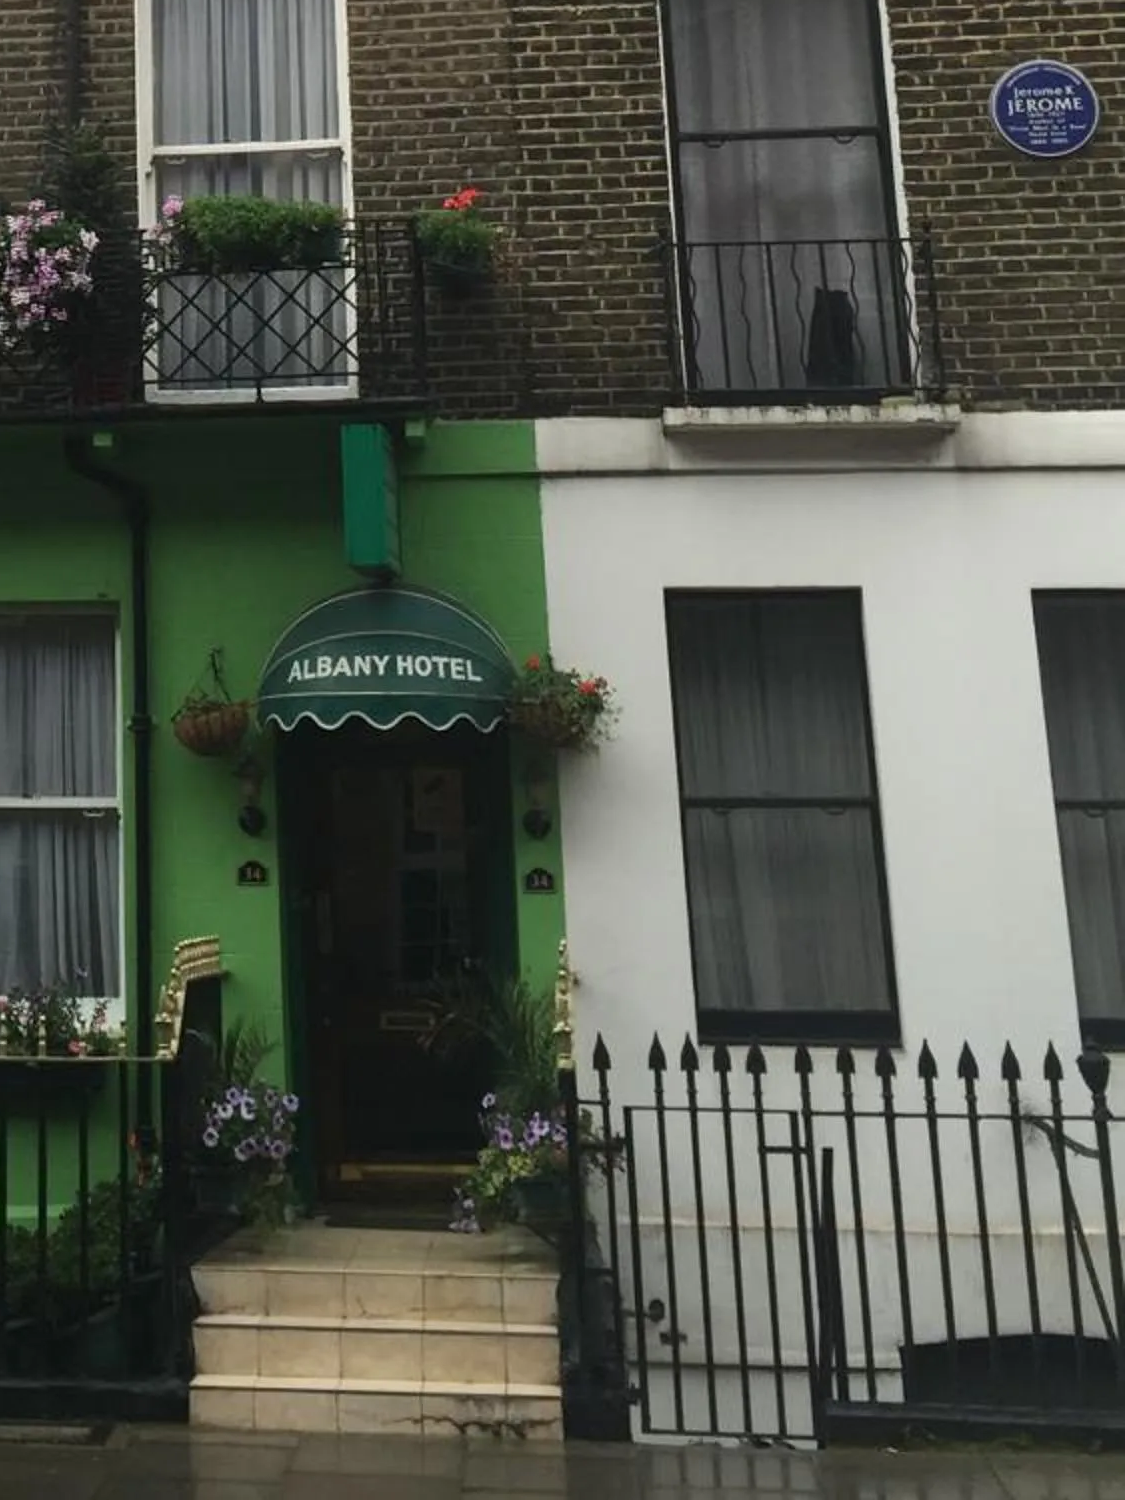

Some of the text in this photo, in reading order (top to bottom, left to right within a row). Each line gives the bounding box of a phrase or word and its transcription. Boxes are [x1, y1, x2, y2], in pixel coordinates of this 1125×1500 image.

[1007, 97, 1084, 116] JEROME
[287, 654, 483, 683] ALBANY HOTEL
